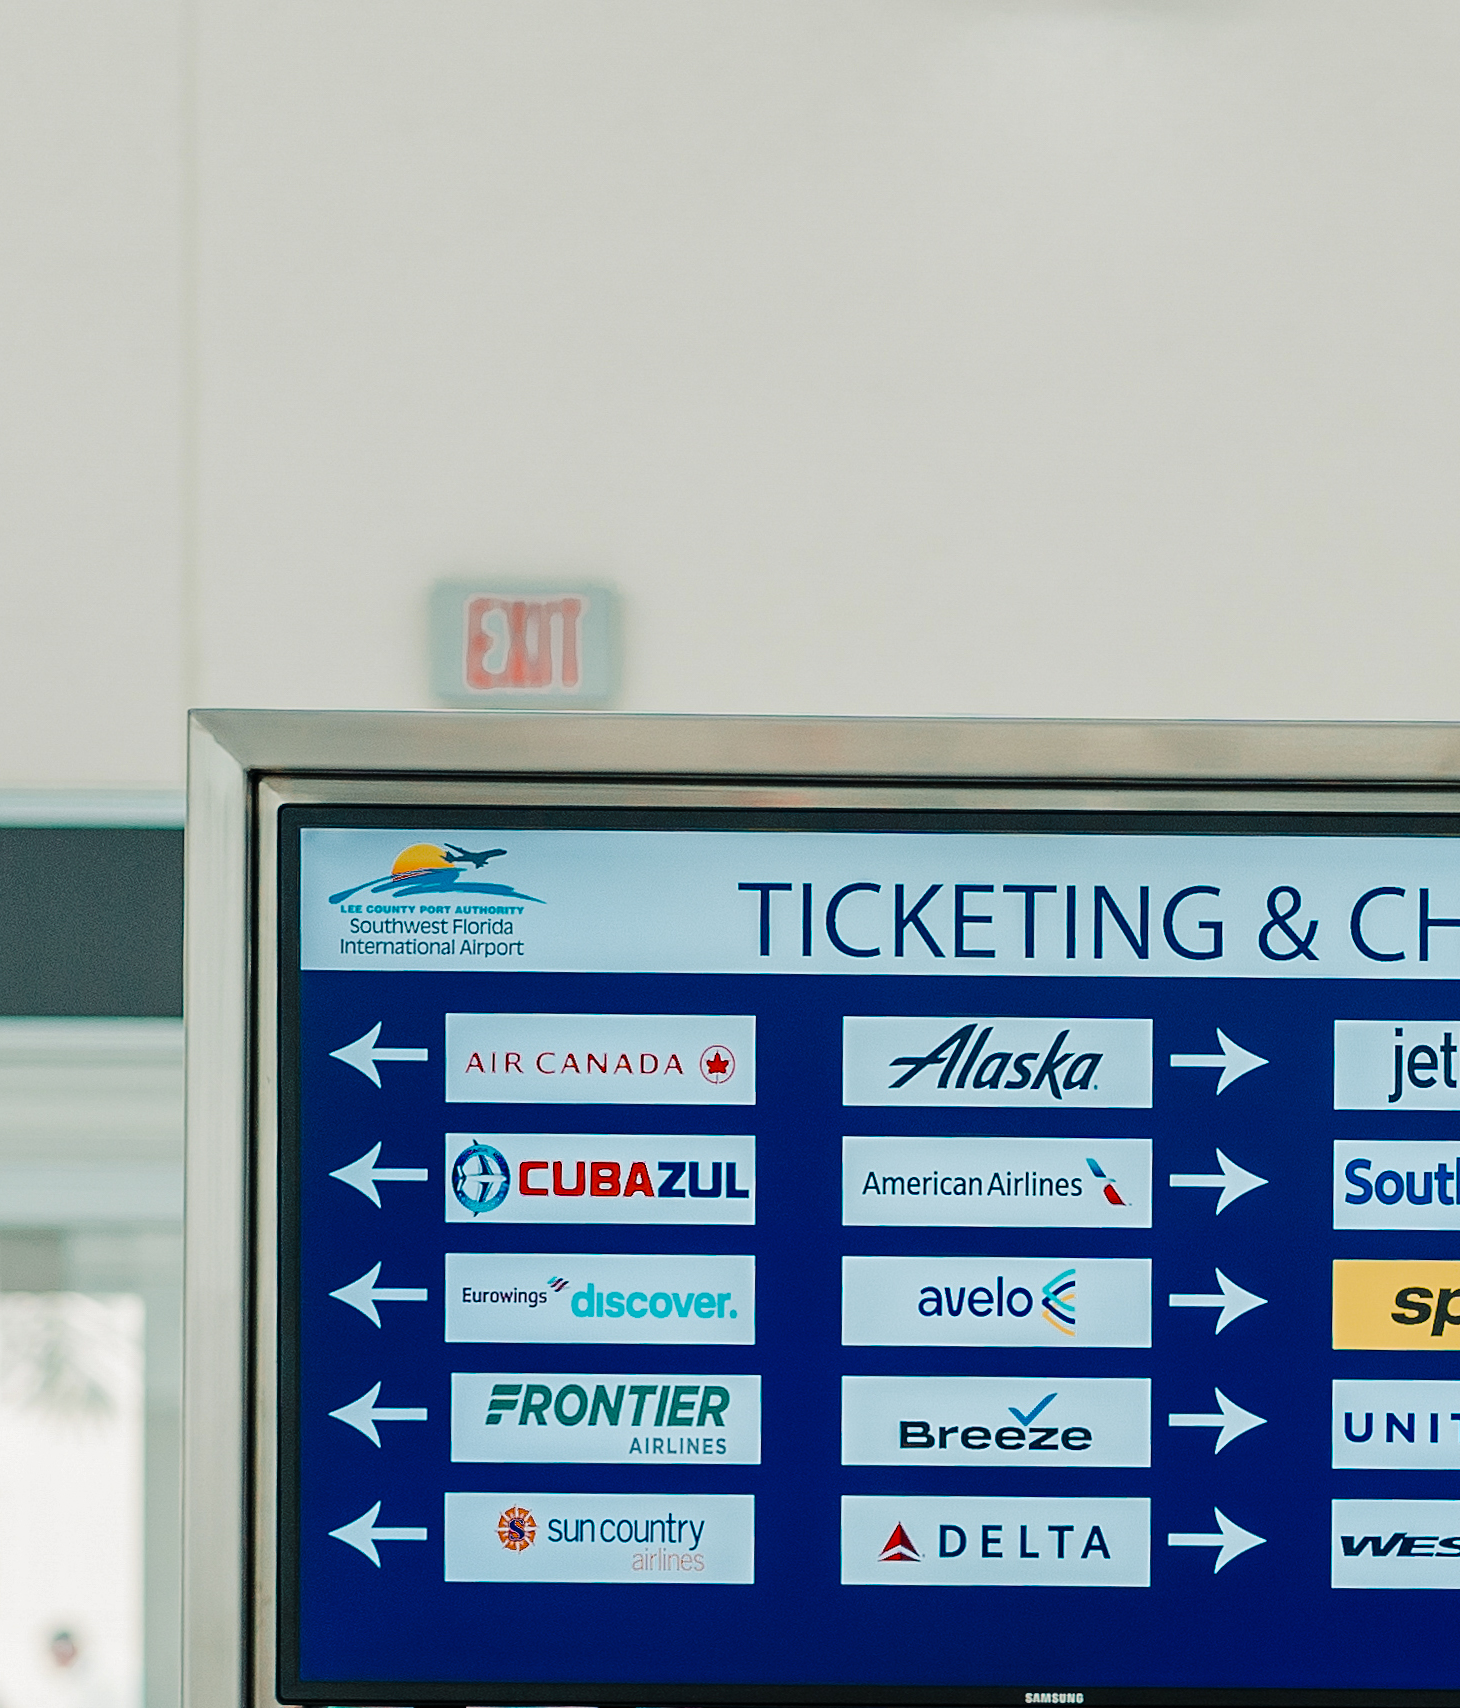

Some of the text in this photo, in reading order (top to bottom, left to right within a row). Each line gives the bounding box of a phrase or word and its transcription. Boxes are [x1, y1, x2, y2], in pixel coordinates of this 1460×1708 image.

[466, 598, 582, 688] EXIT
[341, 905, 524, 914] LEE COUNTY PORT AUTHORITY
[738, 882, 1223, 960] TICKETING
[1258, 886, 1319, 961] &
[350, 918, 513, 934] Southwest Florida
[341, 939, 524, 958] International Airport
[468, 1053, 681, 1073] AIR CANADA
[888, 1024, 1103, 1100] Alaska
[520, 1161, 749, 1199] CUBAZUL
[862, 1171, 1082, 1196] American Airlines
[462, 1288, 547, 1308] Eurowings
[918, 1276, 1033, 1317] avelo
[485, 1384, 730, 1426] FRONTIER
[629, 1438, 726, 1454] AIRLINES
[899, 1417, 1092, 1450] Breeze
[548, 1513, 705, 1550] sun country
[939, 1525, 1110, 1559] DELTA
[630, 1548, 706, 1573] airlines
[1025, 1693, 1084, 1703] SAMSUNG
